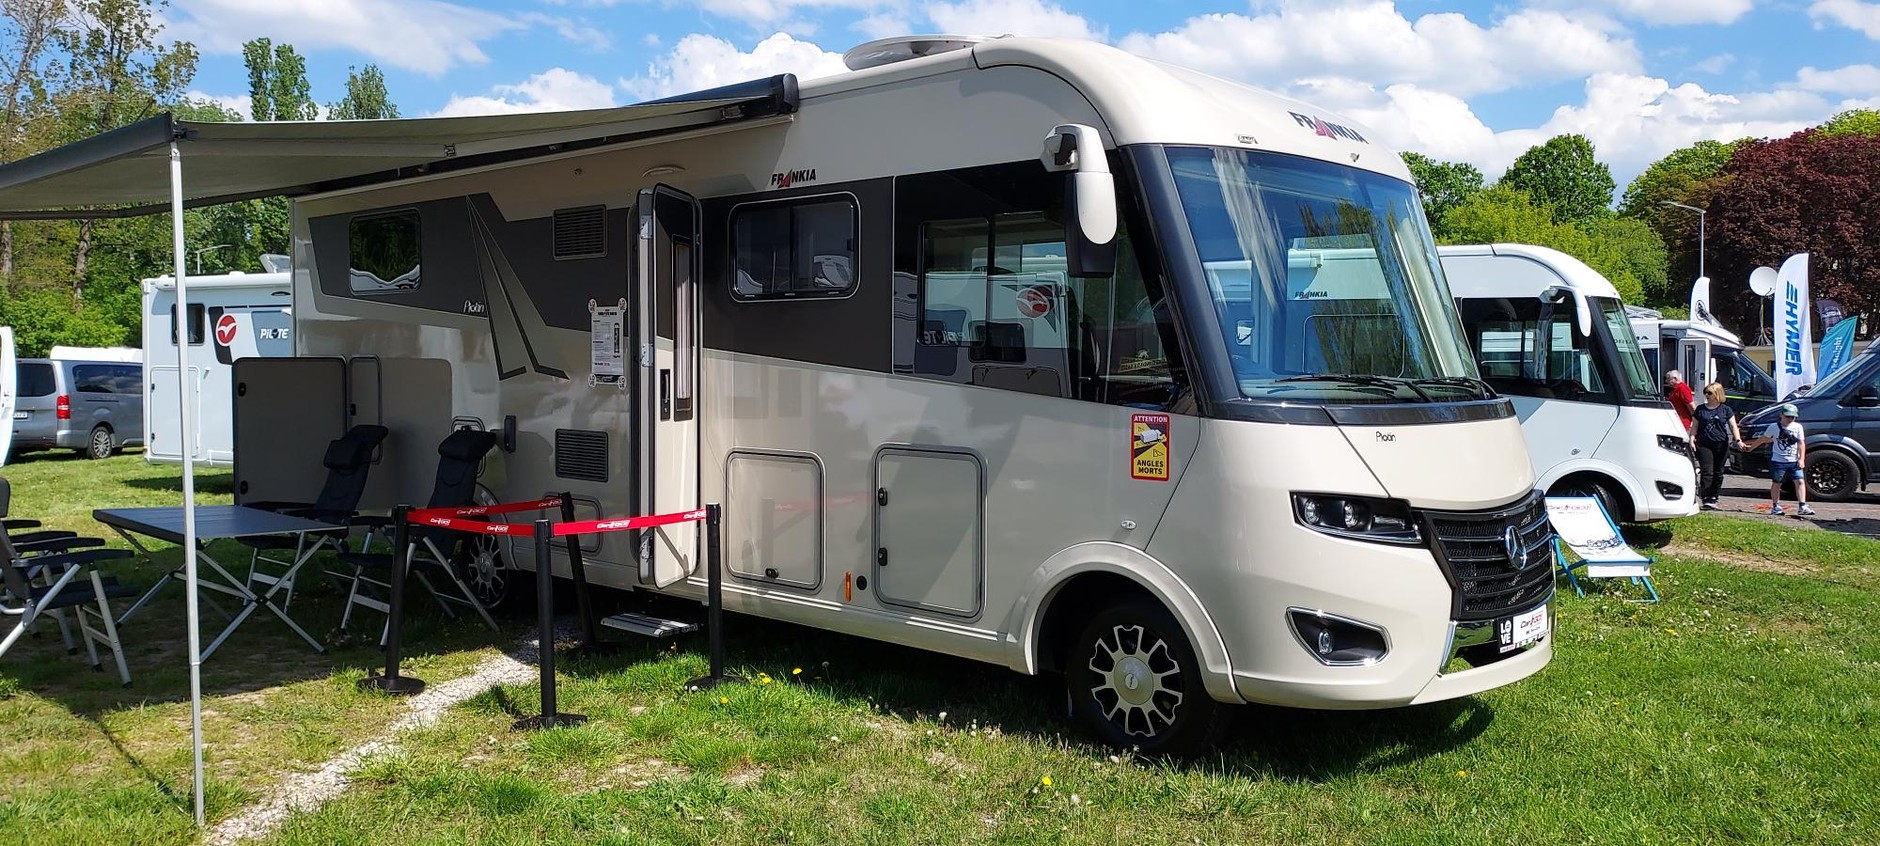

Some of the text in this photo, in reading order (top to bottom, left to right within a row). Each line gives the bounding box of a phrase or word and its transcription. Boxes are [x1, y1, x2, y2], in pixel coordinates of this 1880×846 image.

[1287, 111, 1369, 144] FRANKIA
[771, 169, 817, 188] FRANKIA
[1294, 290, 1328, 299] FRANKIA
[1785, 301, 1803, 376] HYMER
[1133, 415, 1168, 423] ATTENTION
[1138, 467, 1163, 475] MORTS
